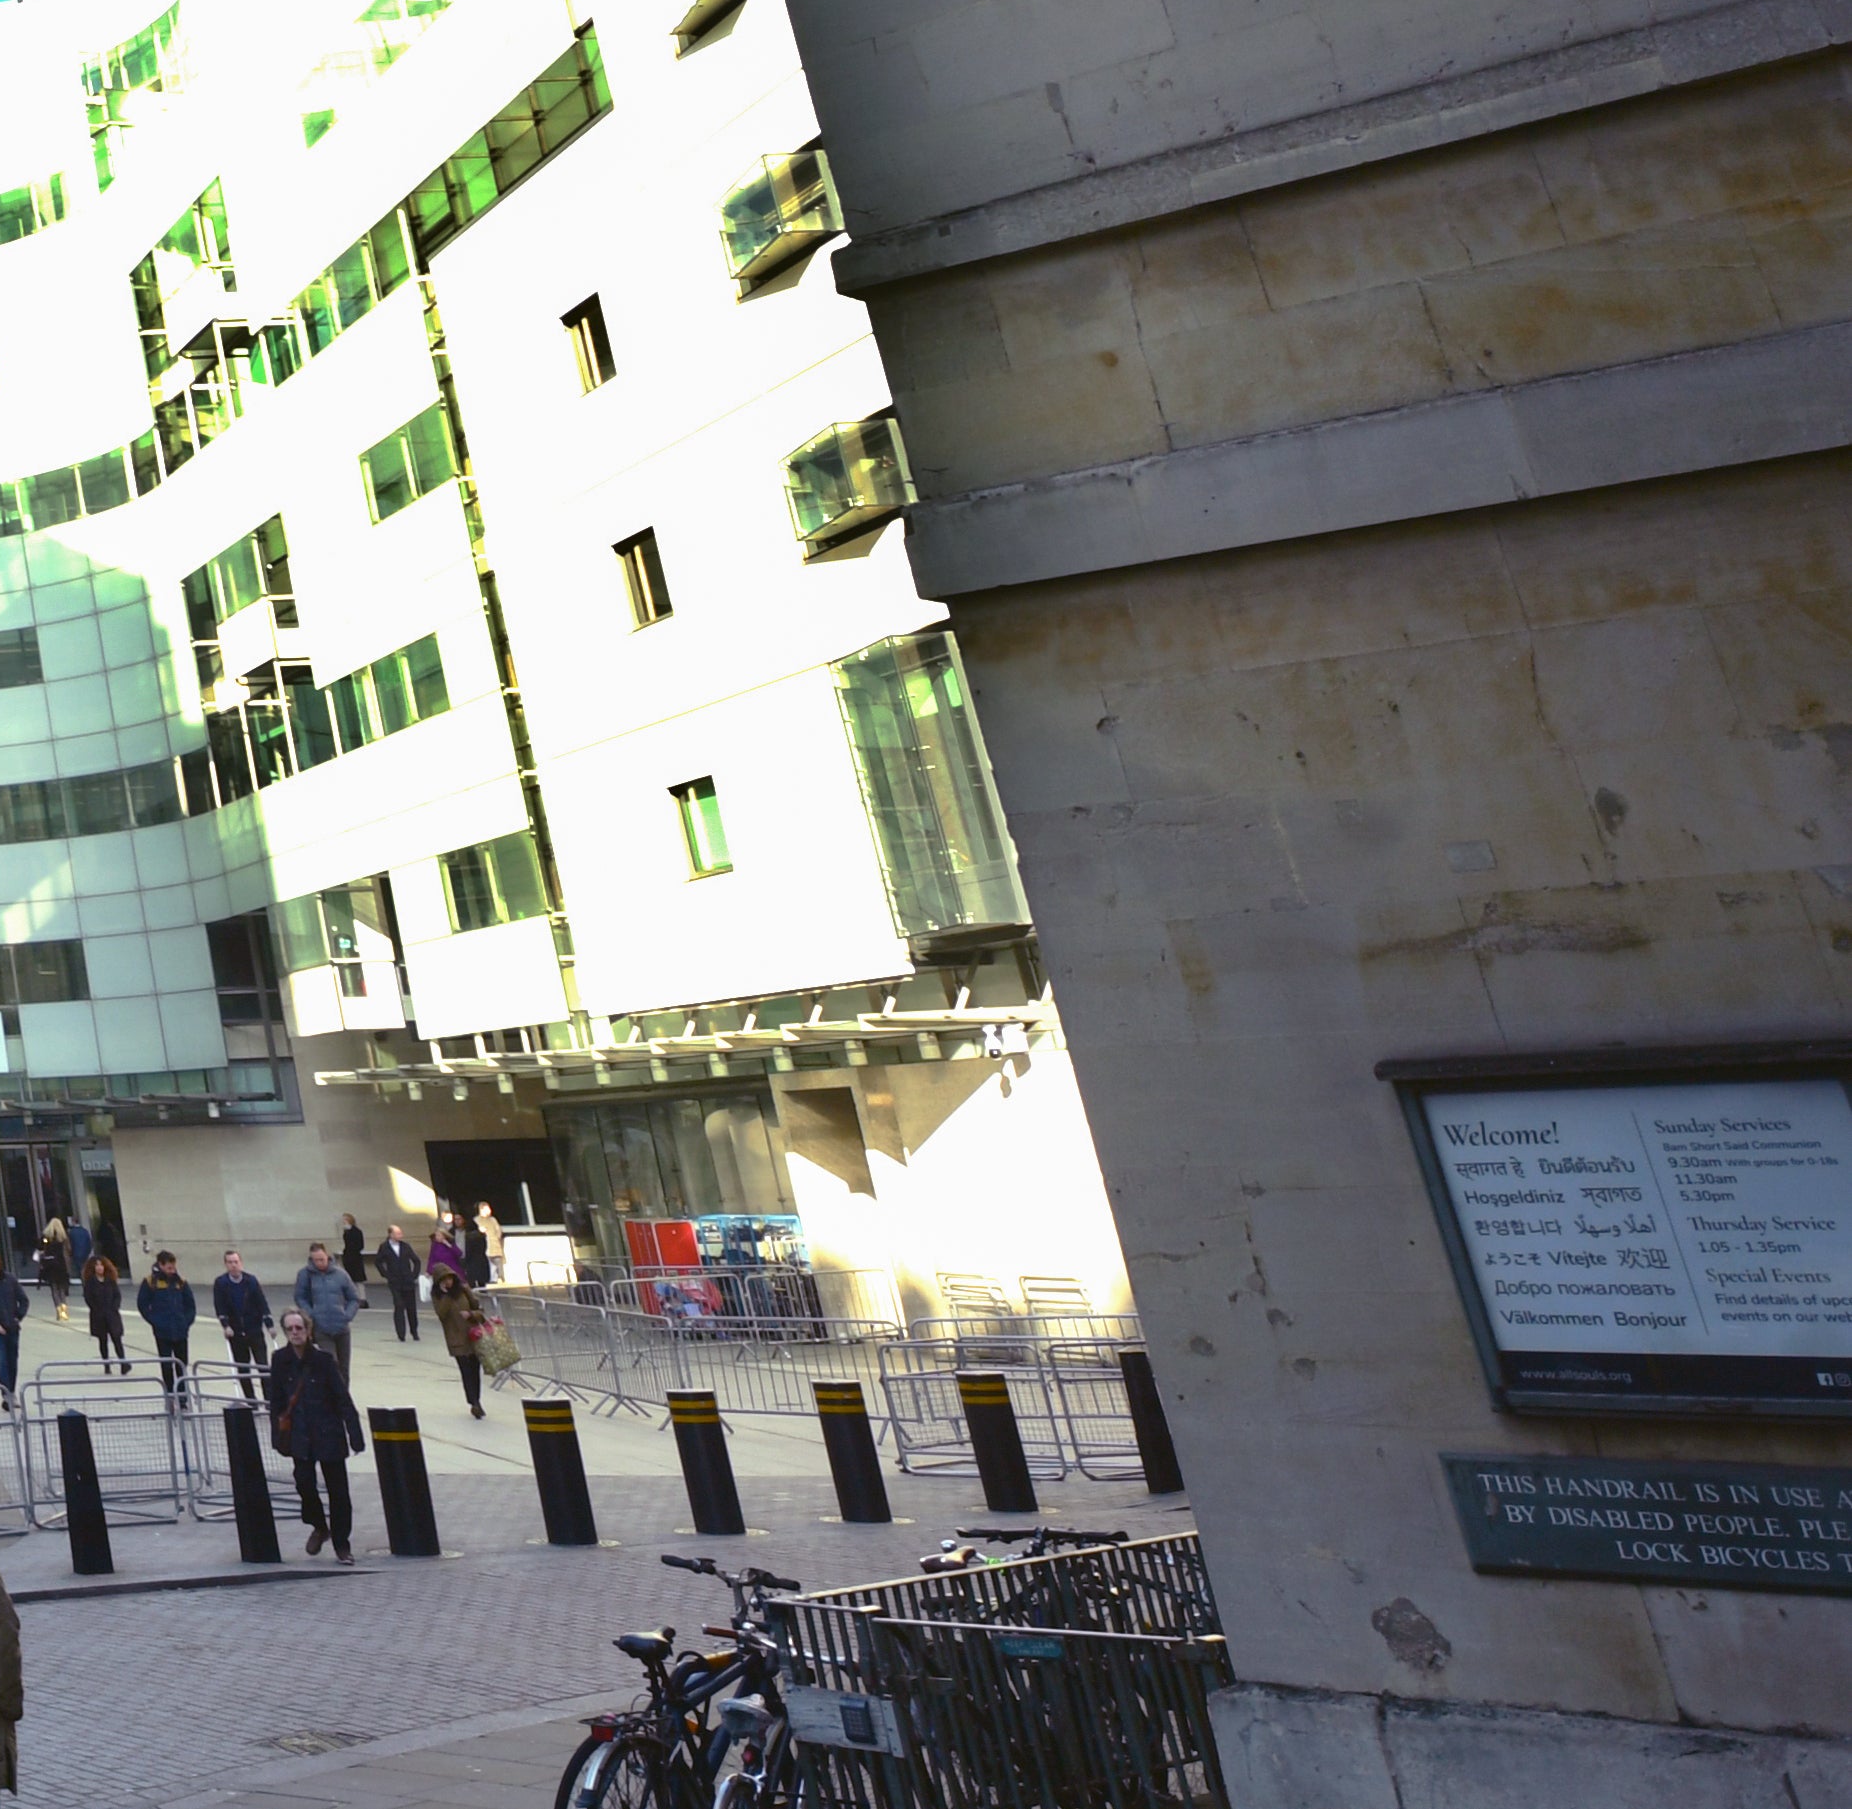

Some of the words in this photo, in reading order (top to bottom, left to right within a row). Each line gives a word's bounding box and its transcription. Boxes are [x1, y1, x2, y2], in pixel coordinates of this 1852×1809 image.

[1443, 1121, 1560, 1147] Welcome!
[1654, 1117, 1715, 1138] Sunday
[1720, 1116, 1791, 1133] Services
[1690, 1142, 1721, 1152] Short
[1724, 1141, 1749, 1151] Said
[1751, 1140, 1821, 1150] Communion
[1667, 1157, 1722, 1168] 9.30am
[1753, 1158, 1788, 1168] groups
[1790, 1157, 1805, 1166] for
[1675, 1173, 1737, 1185] 11.30am
[1464, 1190, 1565, 1207] Hoşgeldiniz
[1680, 1190, 1735, 1203] 5.30pm
[1475, 1219, 1562, 1236] 환영합니다
[1687, 1215, 1767, 1236] Thursday
[1771, 1215, 1836, 1231] Service
[1698, 1241, 1730, 1253] 1.05
[1746, 1241, 1801, 1255] 1.35pm
[1485, 1252, 1542, 1266] ようこそ
[1617, 1248, 1670, 1269] 欢迎
[1705, 1267, 1768, 1287] Special
[1771, 1268, 1831, 1283] Events
[1495, 1280, 1552, 1297] Добро
[1558, 1282, 1676, 1296] пожаловать
[1714, 1293, 1746, 1304] Find
[1751, 1293, 1799, 1305] details
[1803, 1293, 1817, 1305] of
[1614, 1311, 1687, 1329] Bonjour
[1721, 1311, 1768, 1322] events
[1773, 1312, 1791, 1322] on
[1795, 1313, 1819, 1322] our
[1520, 1368, 1632, 1383] www.allsouls.org
[1477, 1473, 1536, 1494] THIS
[1545, 1477, 1686, 1502] HANDRAIL
[1694, 1483, 1720, 1503] IS
[1728, 1485, 1761, 1504] IN
[1770, 1486, 1824, 1508] USE
[1837, 1490, 1852, 1509] A
[1504, 1504, 1535, 1524] BY
[1547, 1507, 1674, 1532] DISABLED
[1684, 1514, 1790, 1538] PEOPLE.
[1616, 1541, 1692, 1564] LOCK
[1699, 1545, 1831, 1571] BICYCLES
